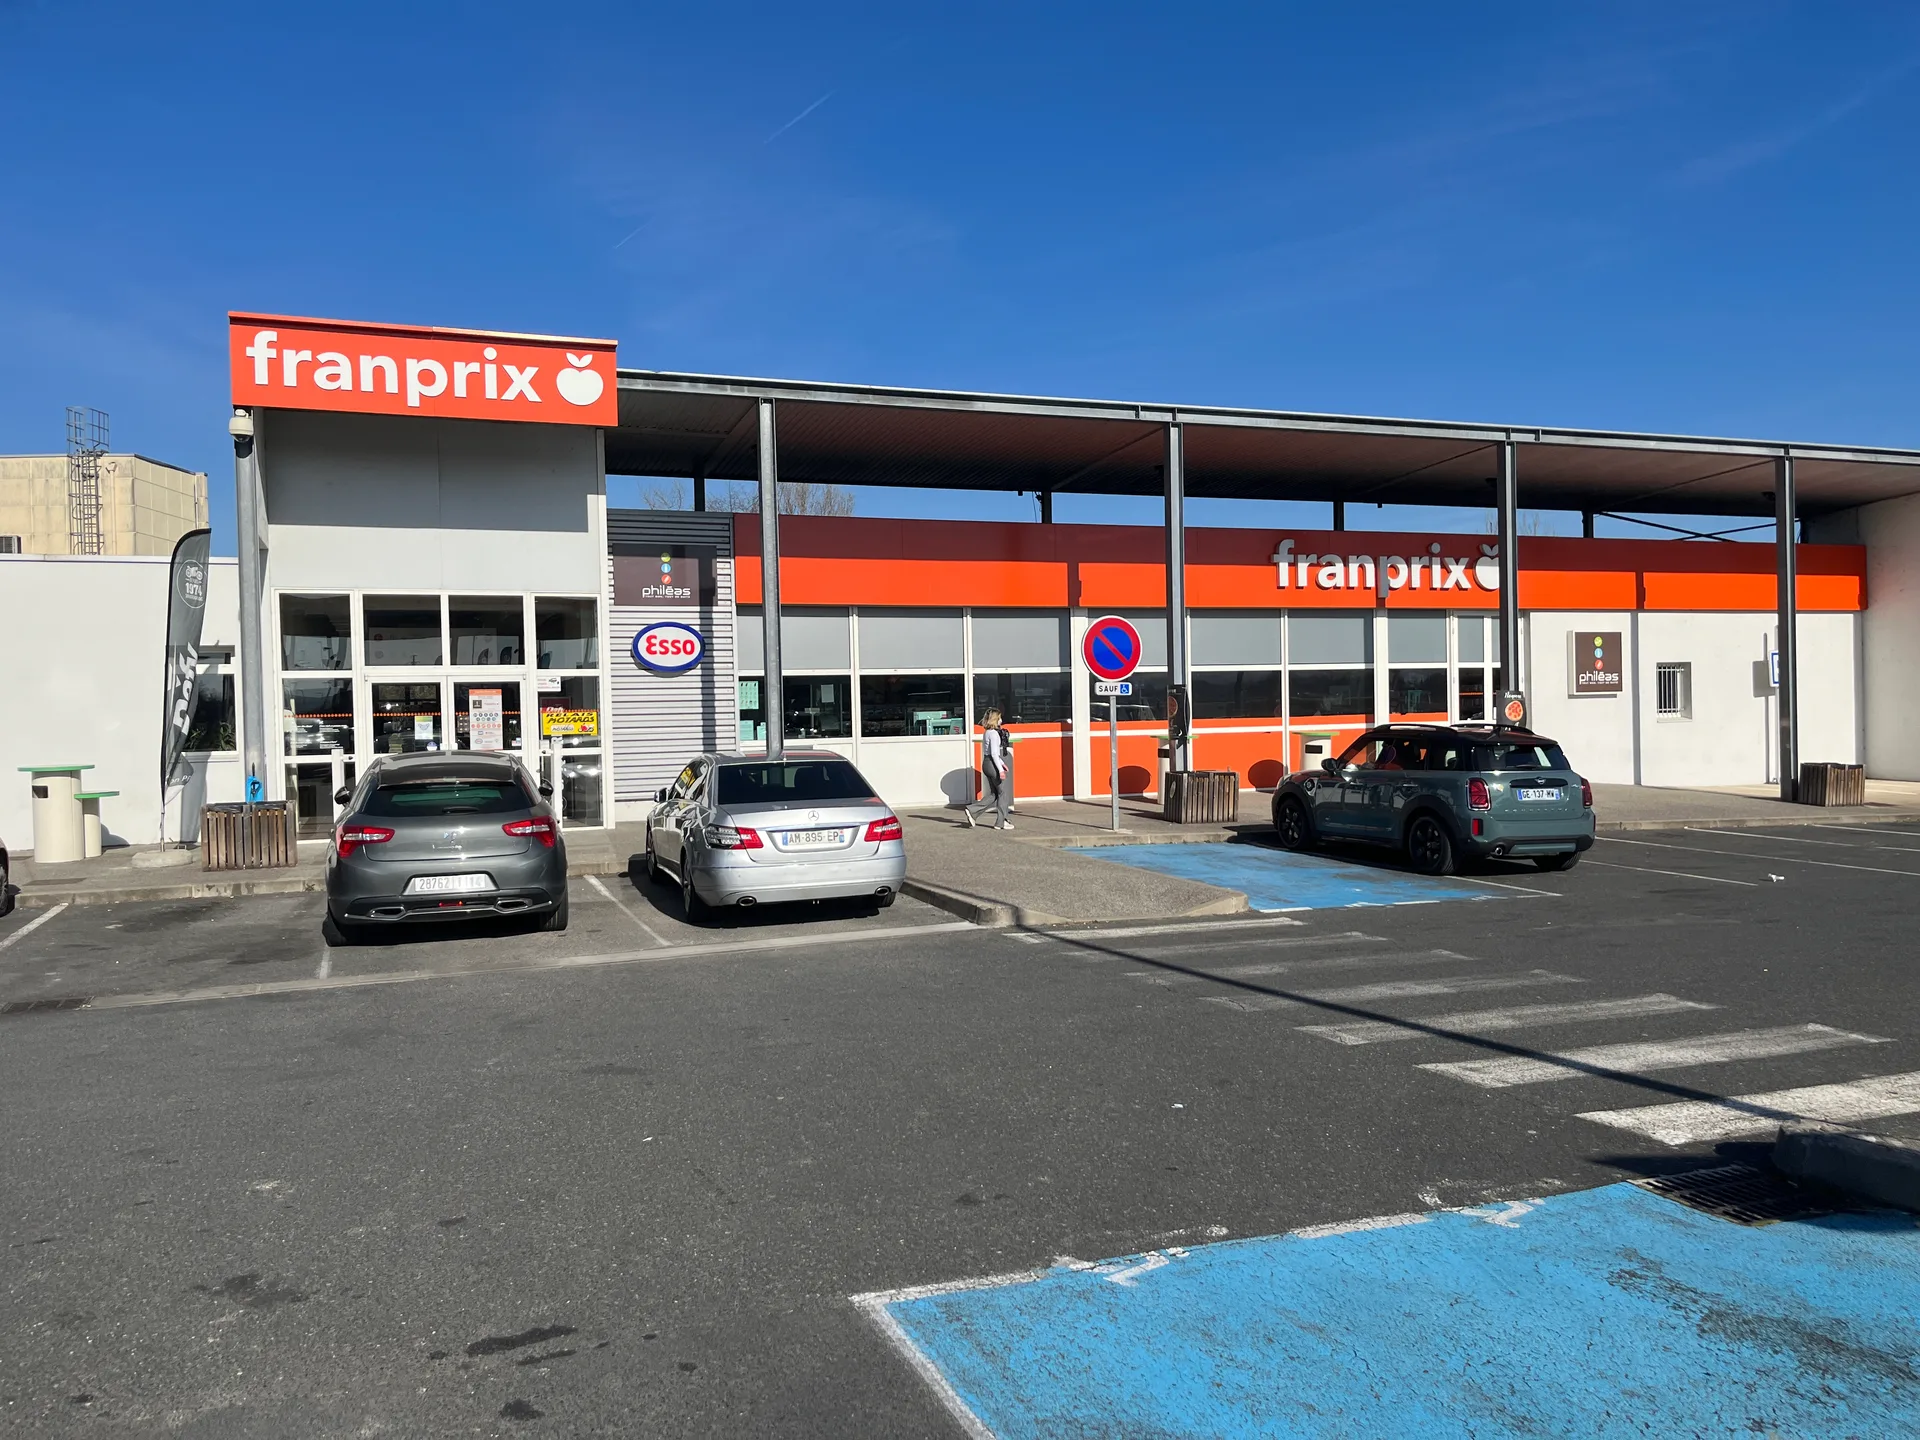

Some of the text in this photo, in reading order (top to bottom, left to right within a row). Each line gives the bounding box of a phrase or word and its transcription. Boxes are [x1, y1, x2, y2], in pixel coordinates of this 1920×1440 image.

[245, 330, 542, 408] franprix
[1272, 538, 1472, 598] franprix
[185, 582, 203, 597] 1974
[645, 634, 695, 655] Esso
[1098, 685, 1119, 693] SAUF
[547, 716, 595, 724] MOTARDS
[419, 877, 450, 890] 28762
